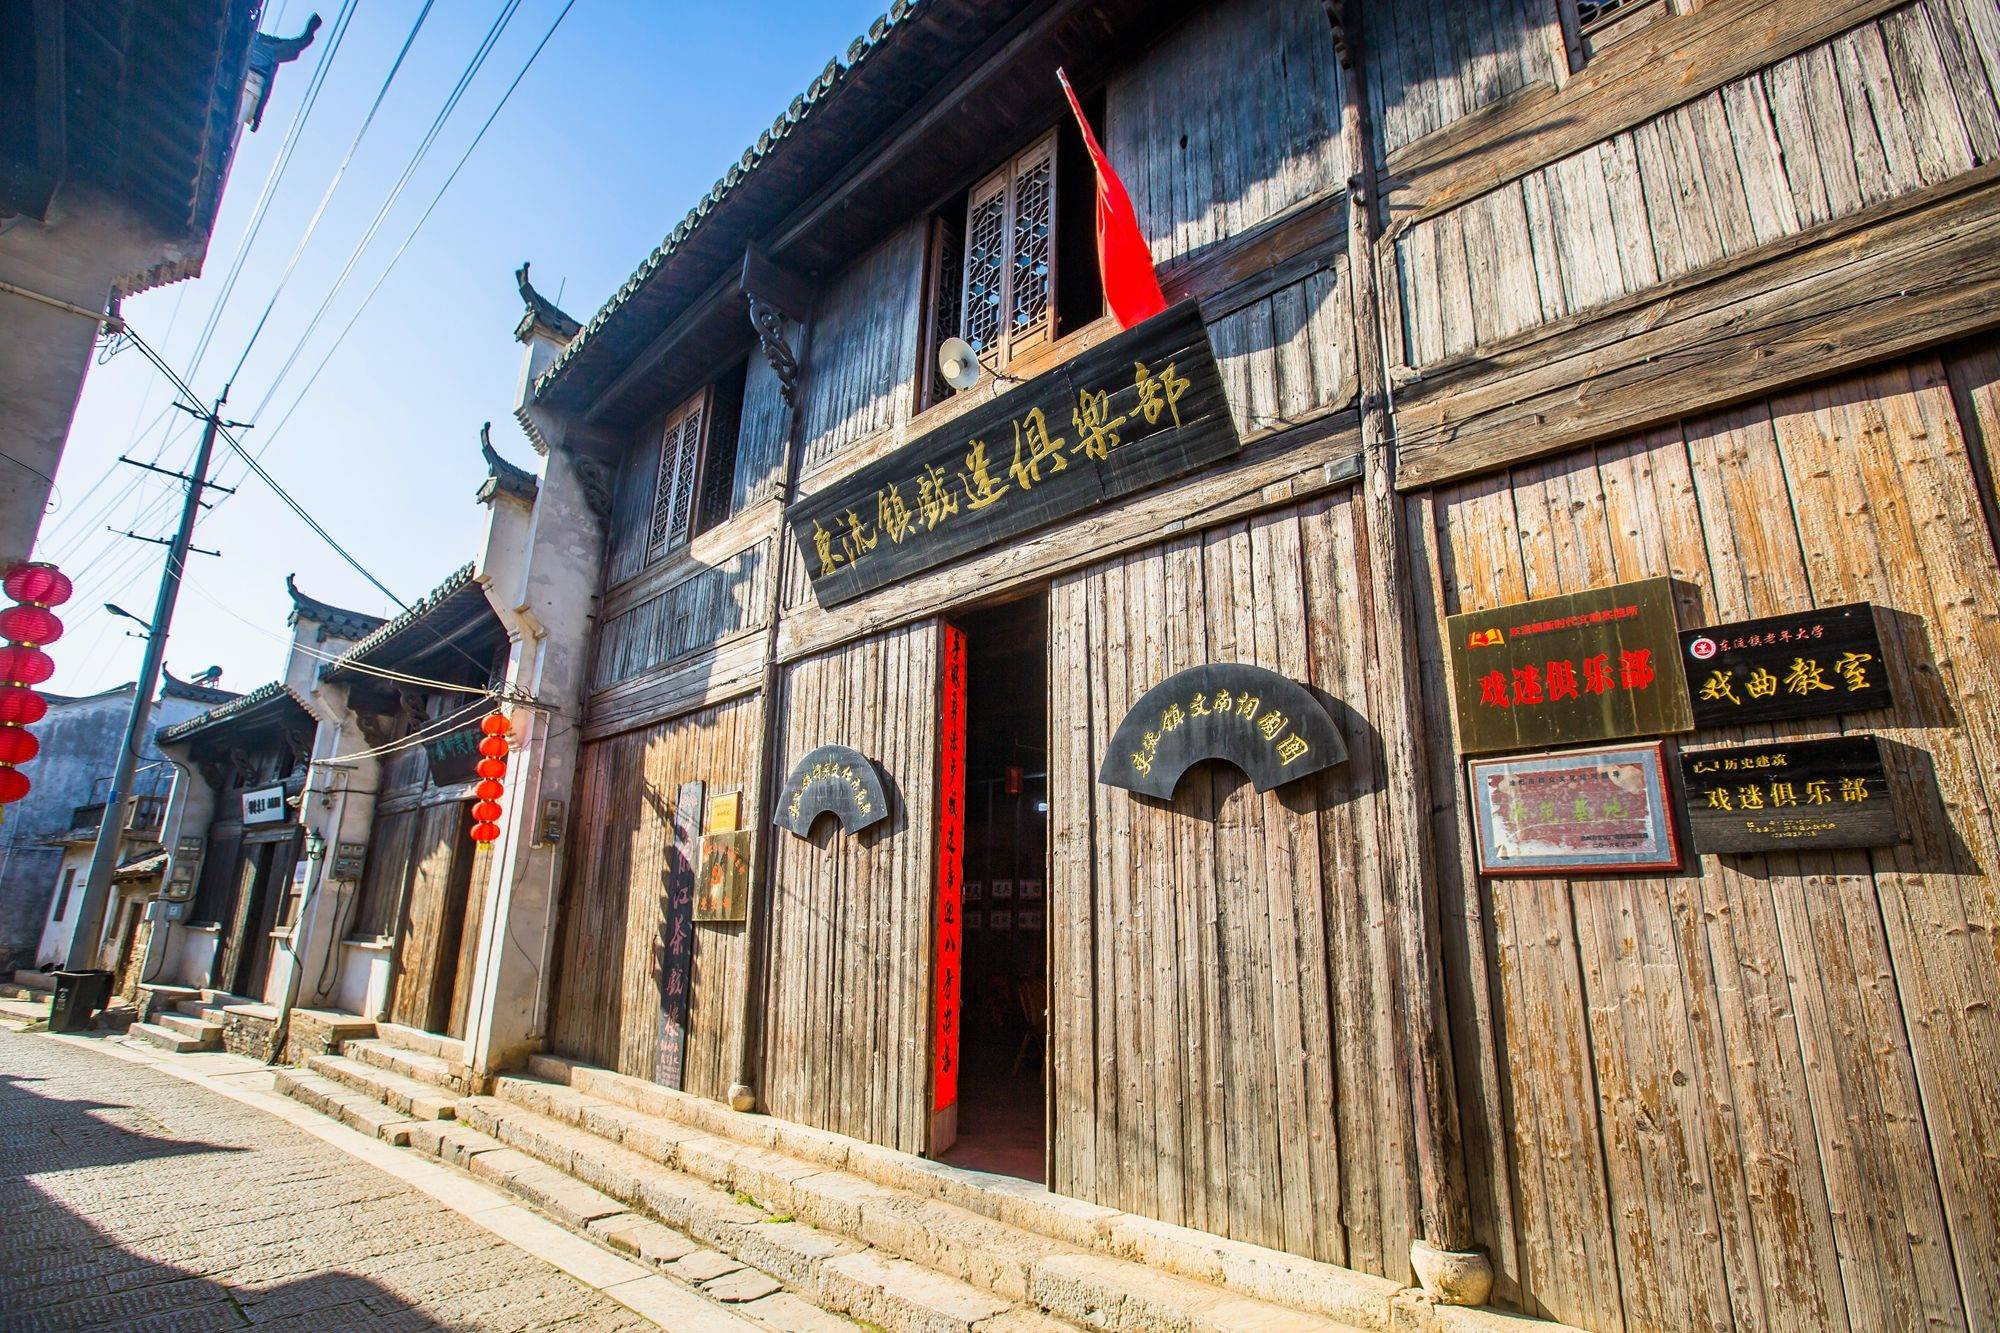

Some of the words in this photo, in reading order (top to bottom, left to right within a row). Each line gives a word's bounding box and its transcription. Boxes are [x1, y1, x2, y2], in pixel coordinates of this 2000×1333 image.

[1719, 624, 1824, 652] 东流镇老年大学
[1477, 648, 1655, 709] 戏迷俱乐部
[1699, 652, 1873, 705] 戏曲教室
[1725, 754, 1788, 771] 历史建筑
[1704, 778, 1869, 812] 戏迷俱乐部
